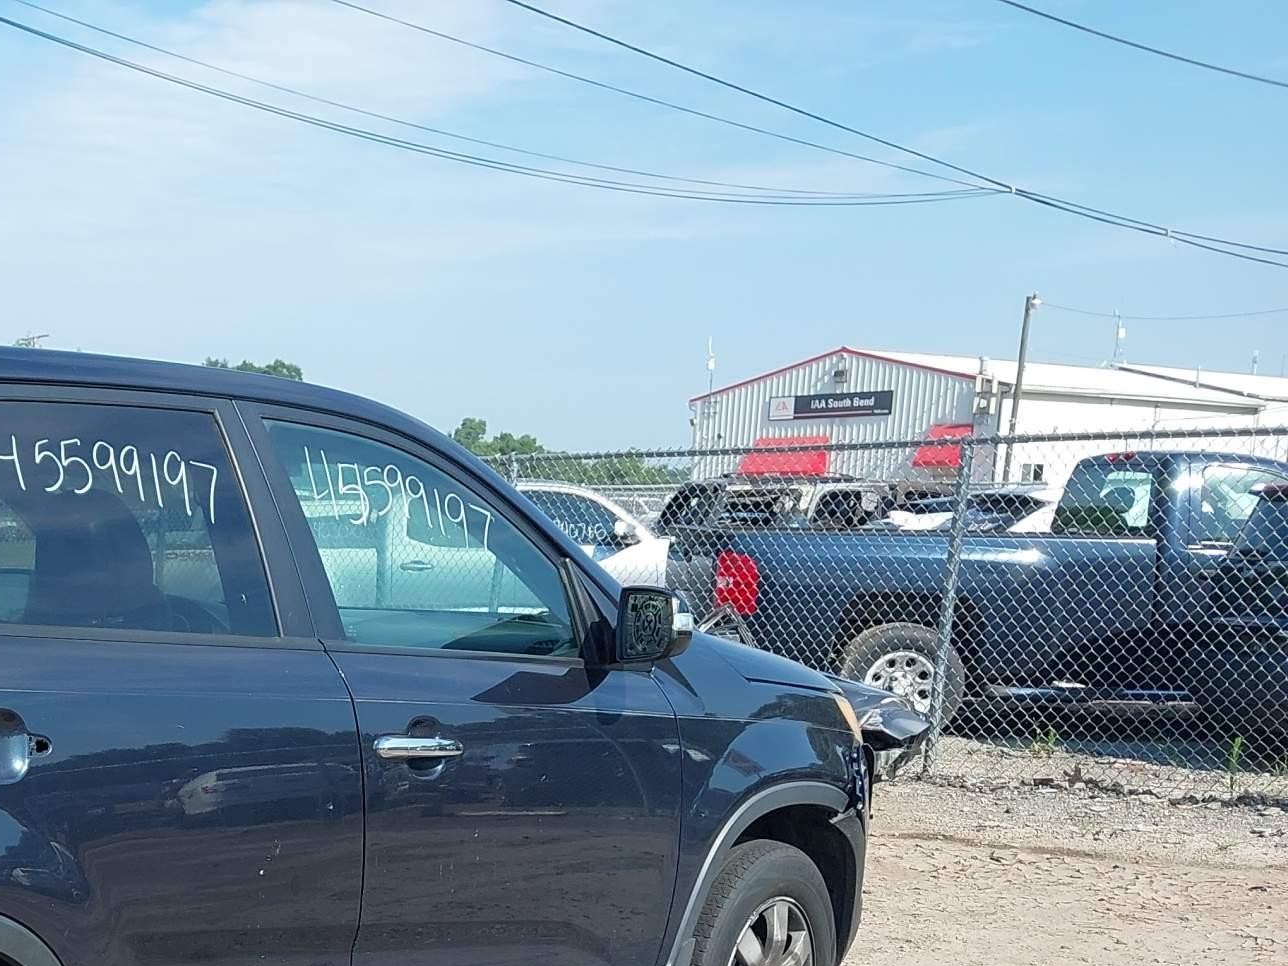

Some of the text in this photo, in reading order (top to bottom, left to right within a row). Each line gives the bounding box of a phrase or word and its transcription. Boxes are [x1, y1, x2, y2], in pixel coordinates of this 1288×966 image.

[810, 396, 875, 409] IAA South Bend
